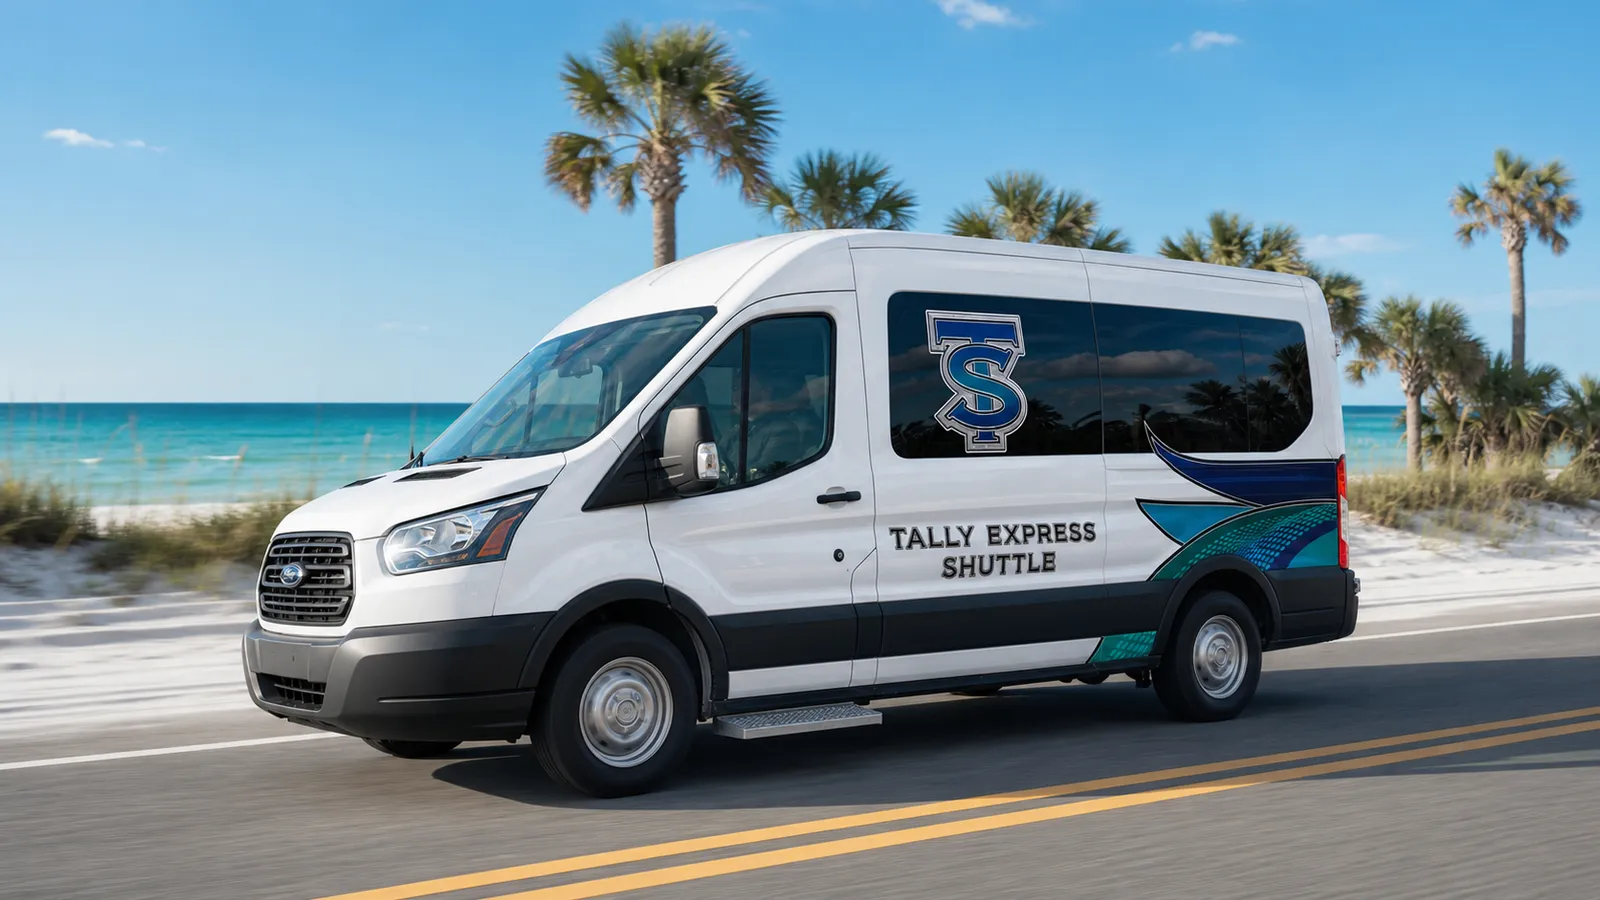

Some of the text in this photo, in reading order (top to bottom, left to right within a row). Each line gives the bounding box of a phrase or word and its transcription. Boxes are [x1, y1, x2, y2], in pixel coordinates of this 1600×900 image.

[889, 522, 1096, 550] TALLY EXPRESS
[941, 551, 1056, 579] SHUTTLE
